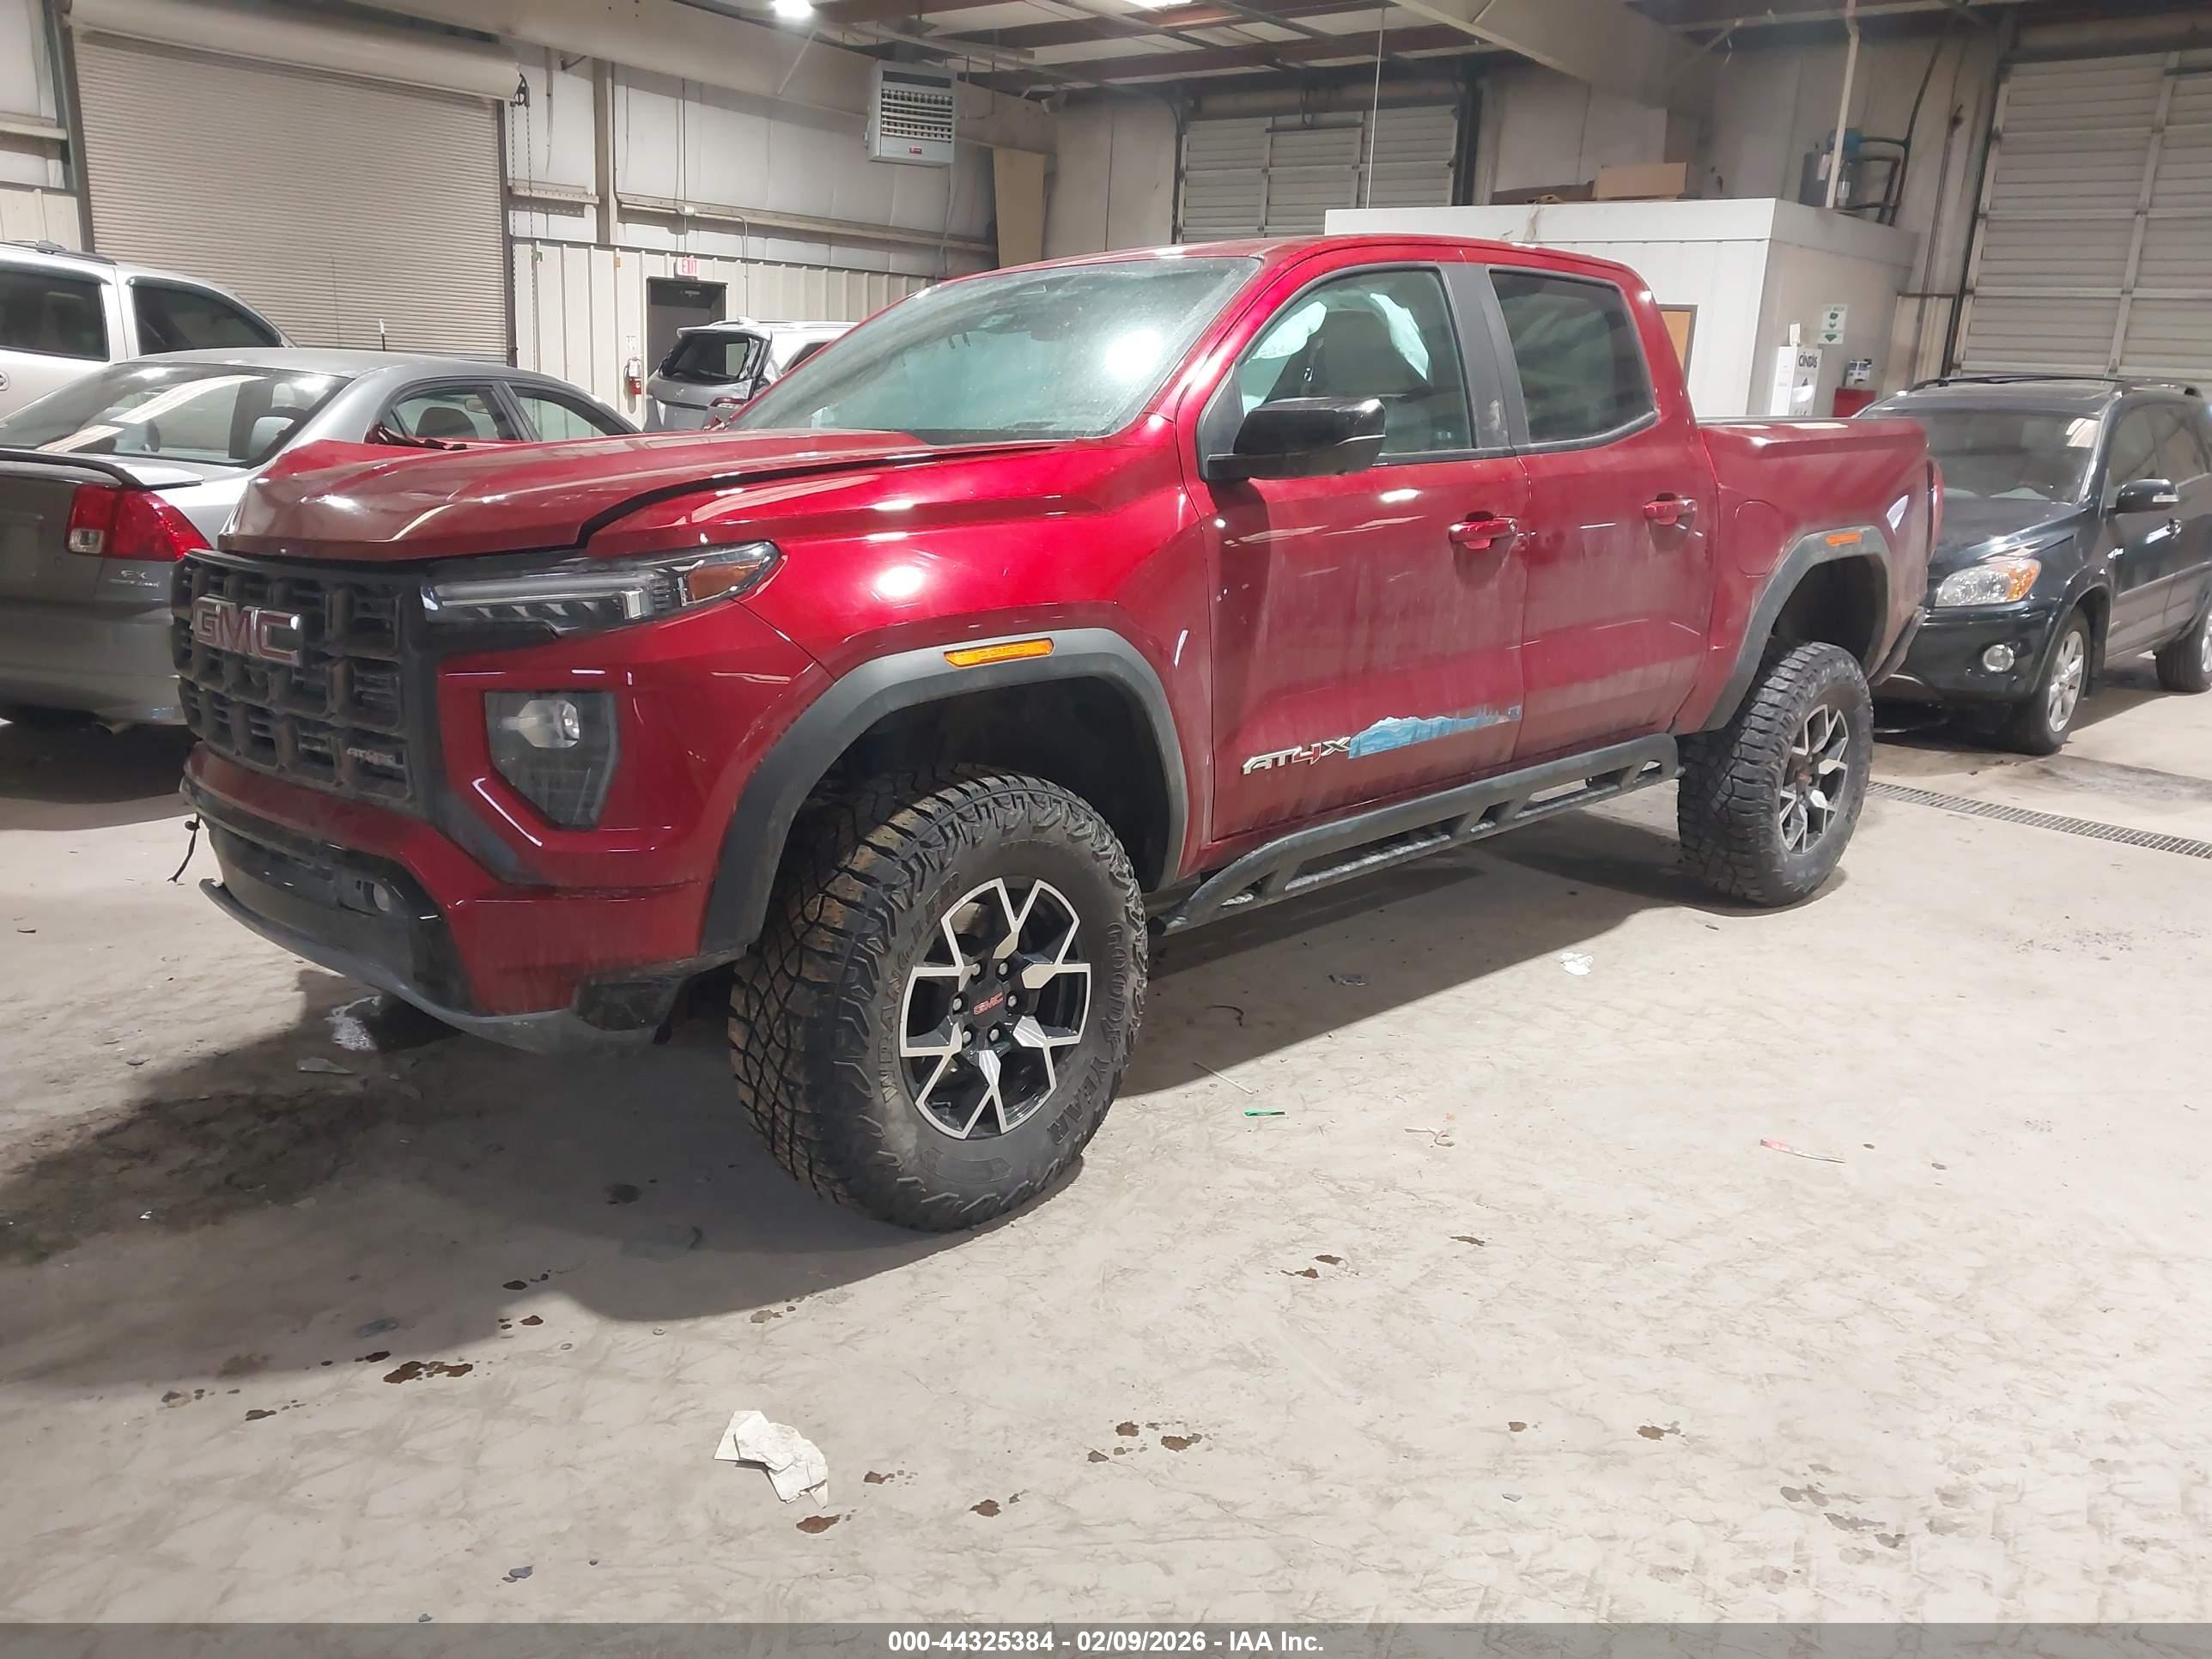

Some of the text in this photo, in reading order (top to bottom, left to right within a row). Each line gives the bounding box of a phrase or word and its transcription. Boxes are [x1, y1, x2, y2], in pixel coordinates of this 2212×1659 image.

[192, 594, 301, 667] GMC
[1242, 736, 1351, 775] AT4X
[973, 991, 1004, 1015] GMC
